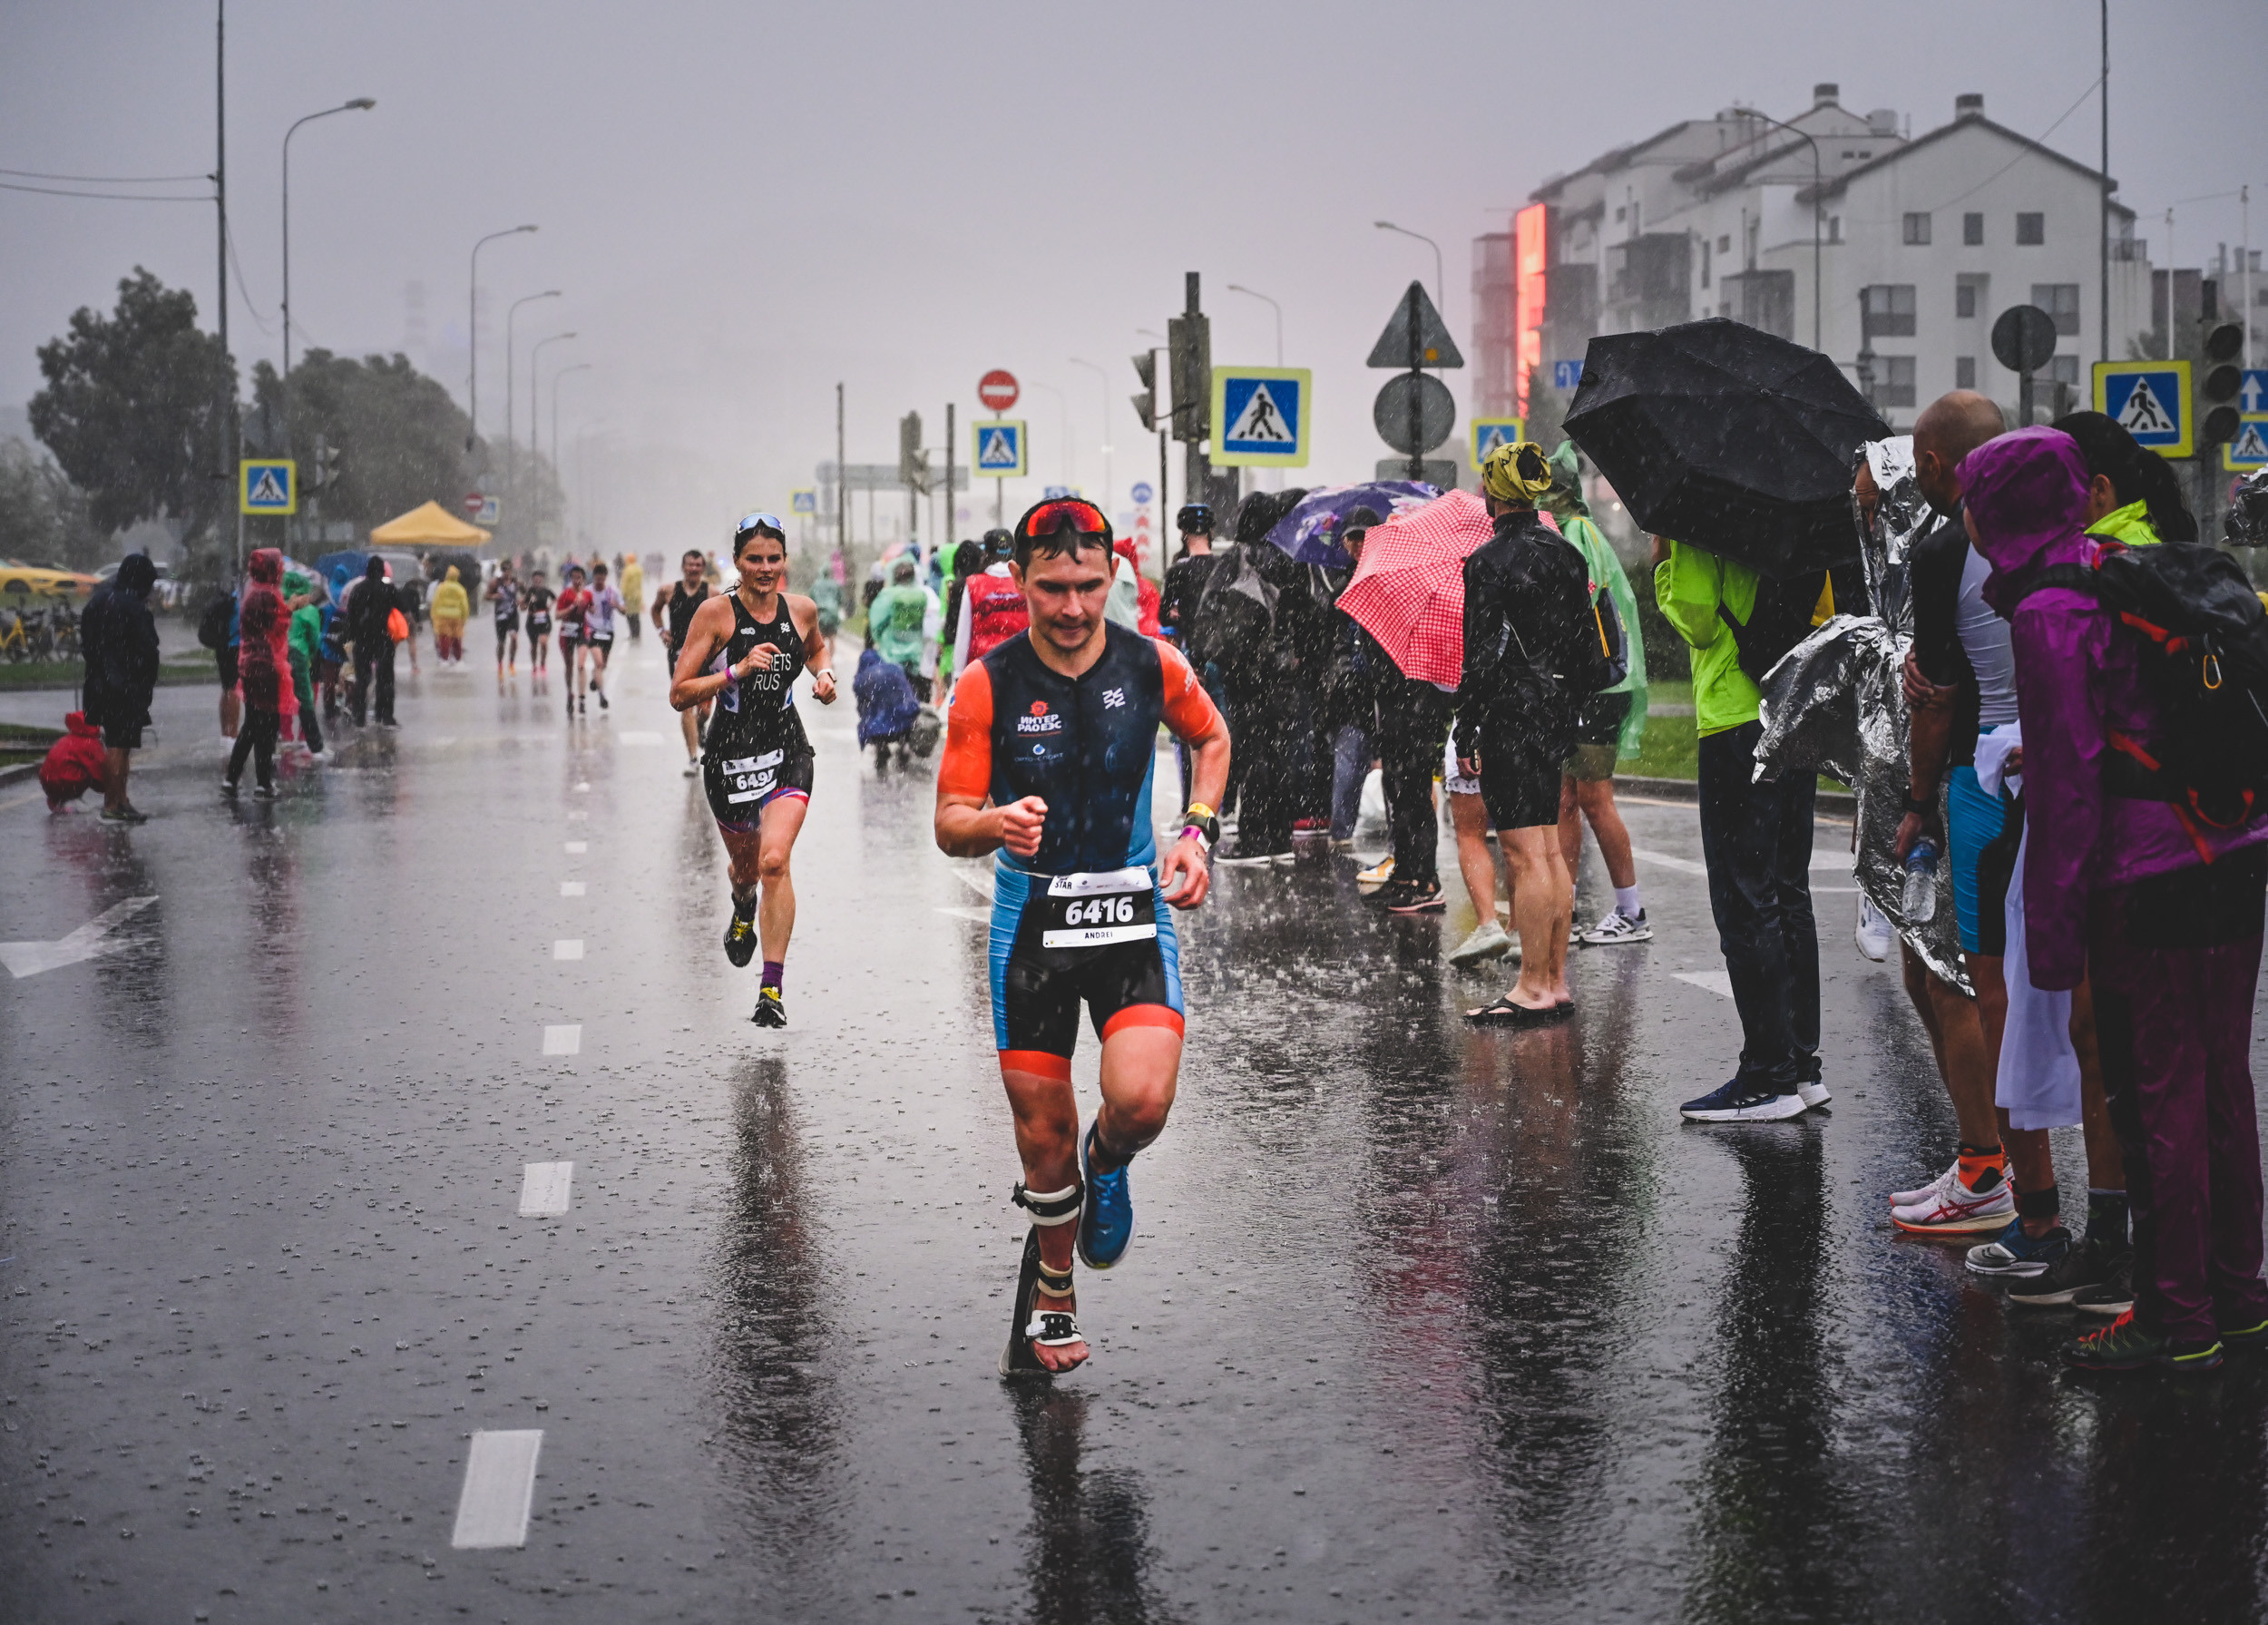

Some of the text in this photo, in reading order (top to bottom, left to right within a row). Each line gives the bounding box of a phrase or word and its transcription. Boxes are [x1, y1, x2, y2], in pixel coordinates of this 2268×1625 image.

[753, 673, 781, 690] RUS
[1020, 713, 1060, 724] ИНТЕР
[1055, 881, 1072, 889] STAR
[1065, 896, 1134, 925] 6416
[1084, 931, 1113, 939] ANDREI
